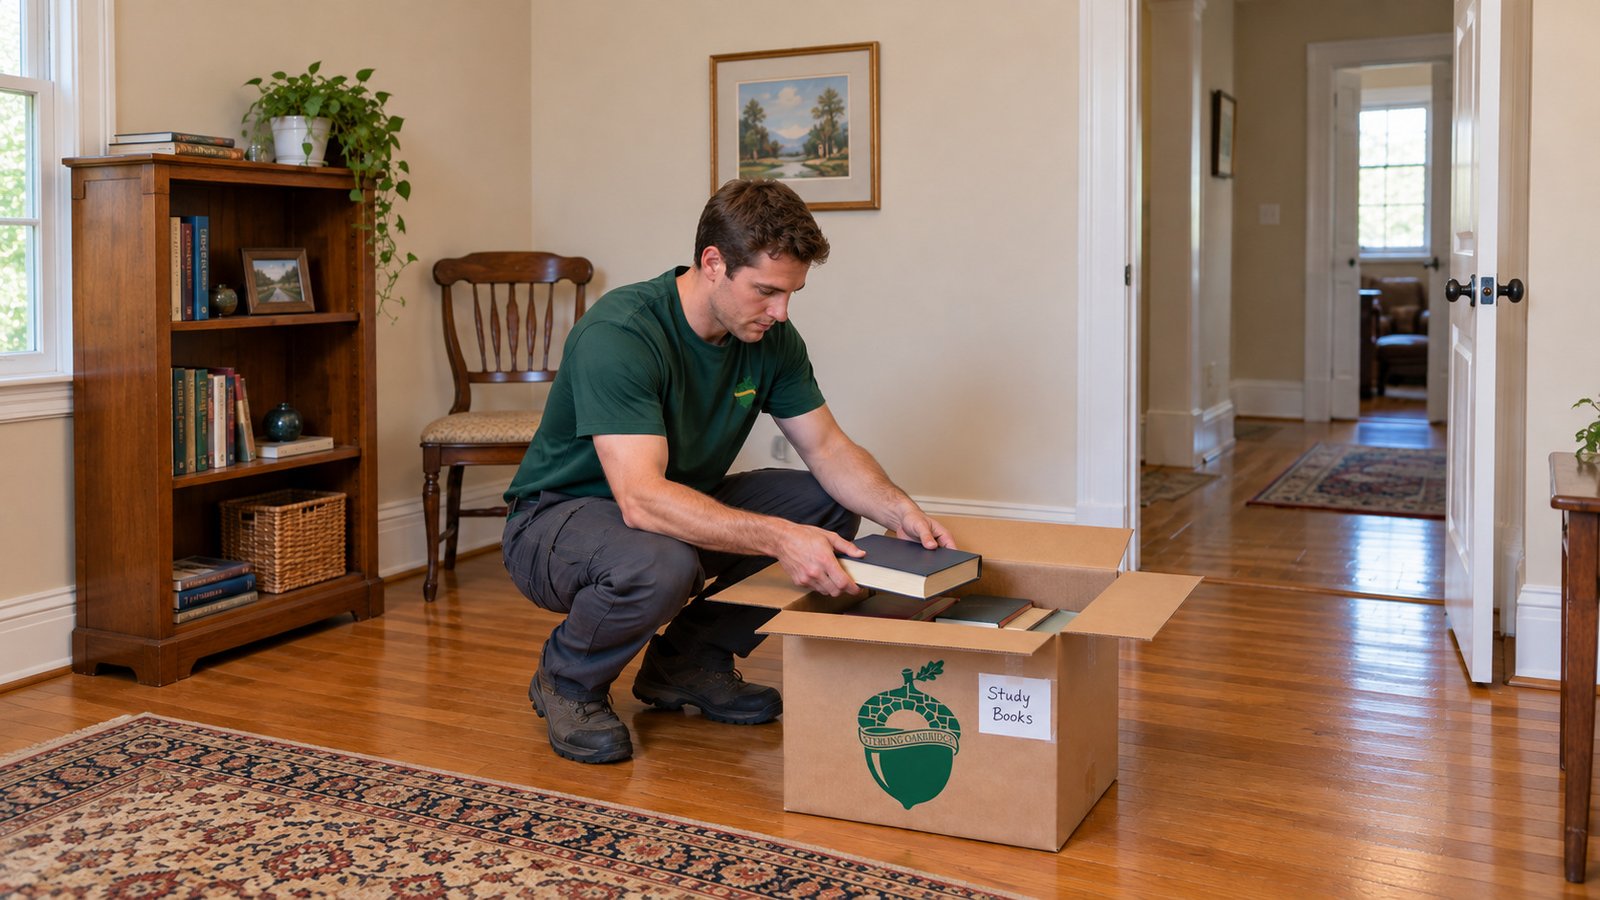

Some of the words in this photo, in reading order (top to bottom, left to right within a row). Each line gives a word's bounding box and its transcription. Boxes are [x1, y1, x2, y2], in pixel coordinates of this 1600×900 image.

[987, 686, 1031, 709] Study
[992, 706, 1033, 725] Books
[863, 734, 904, 746] STERLING
